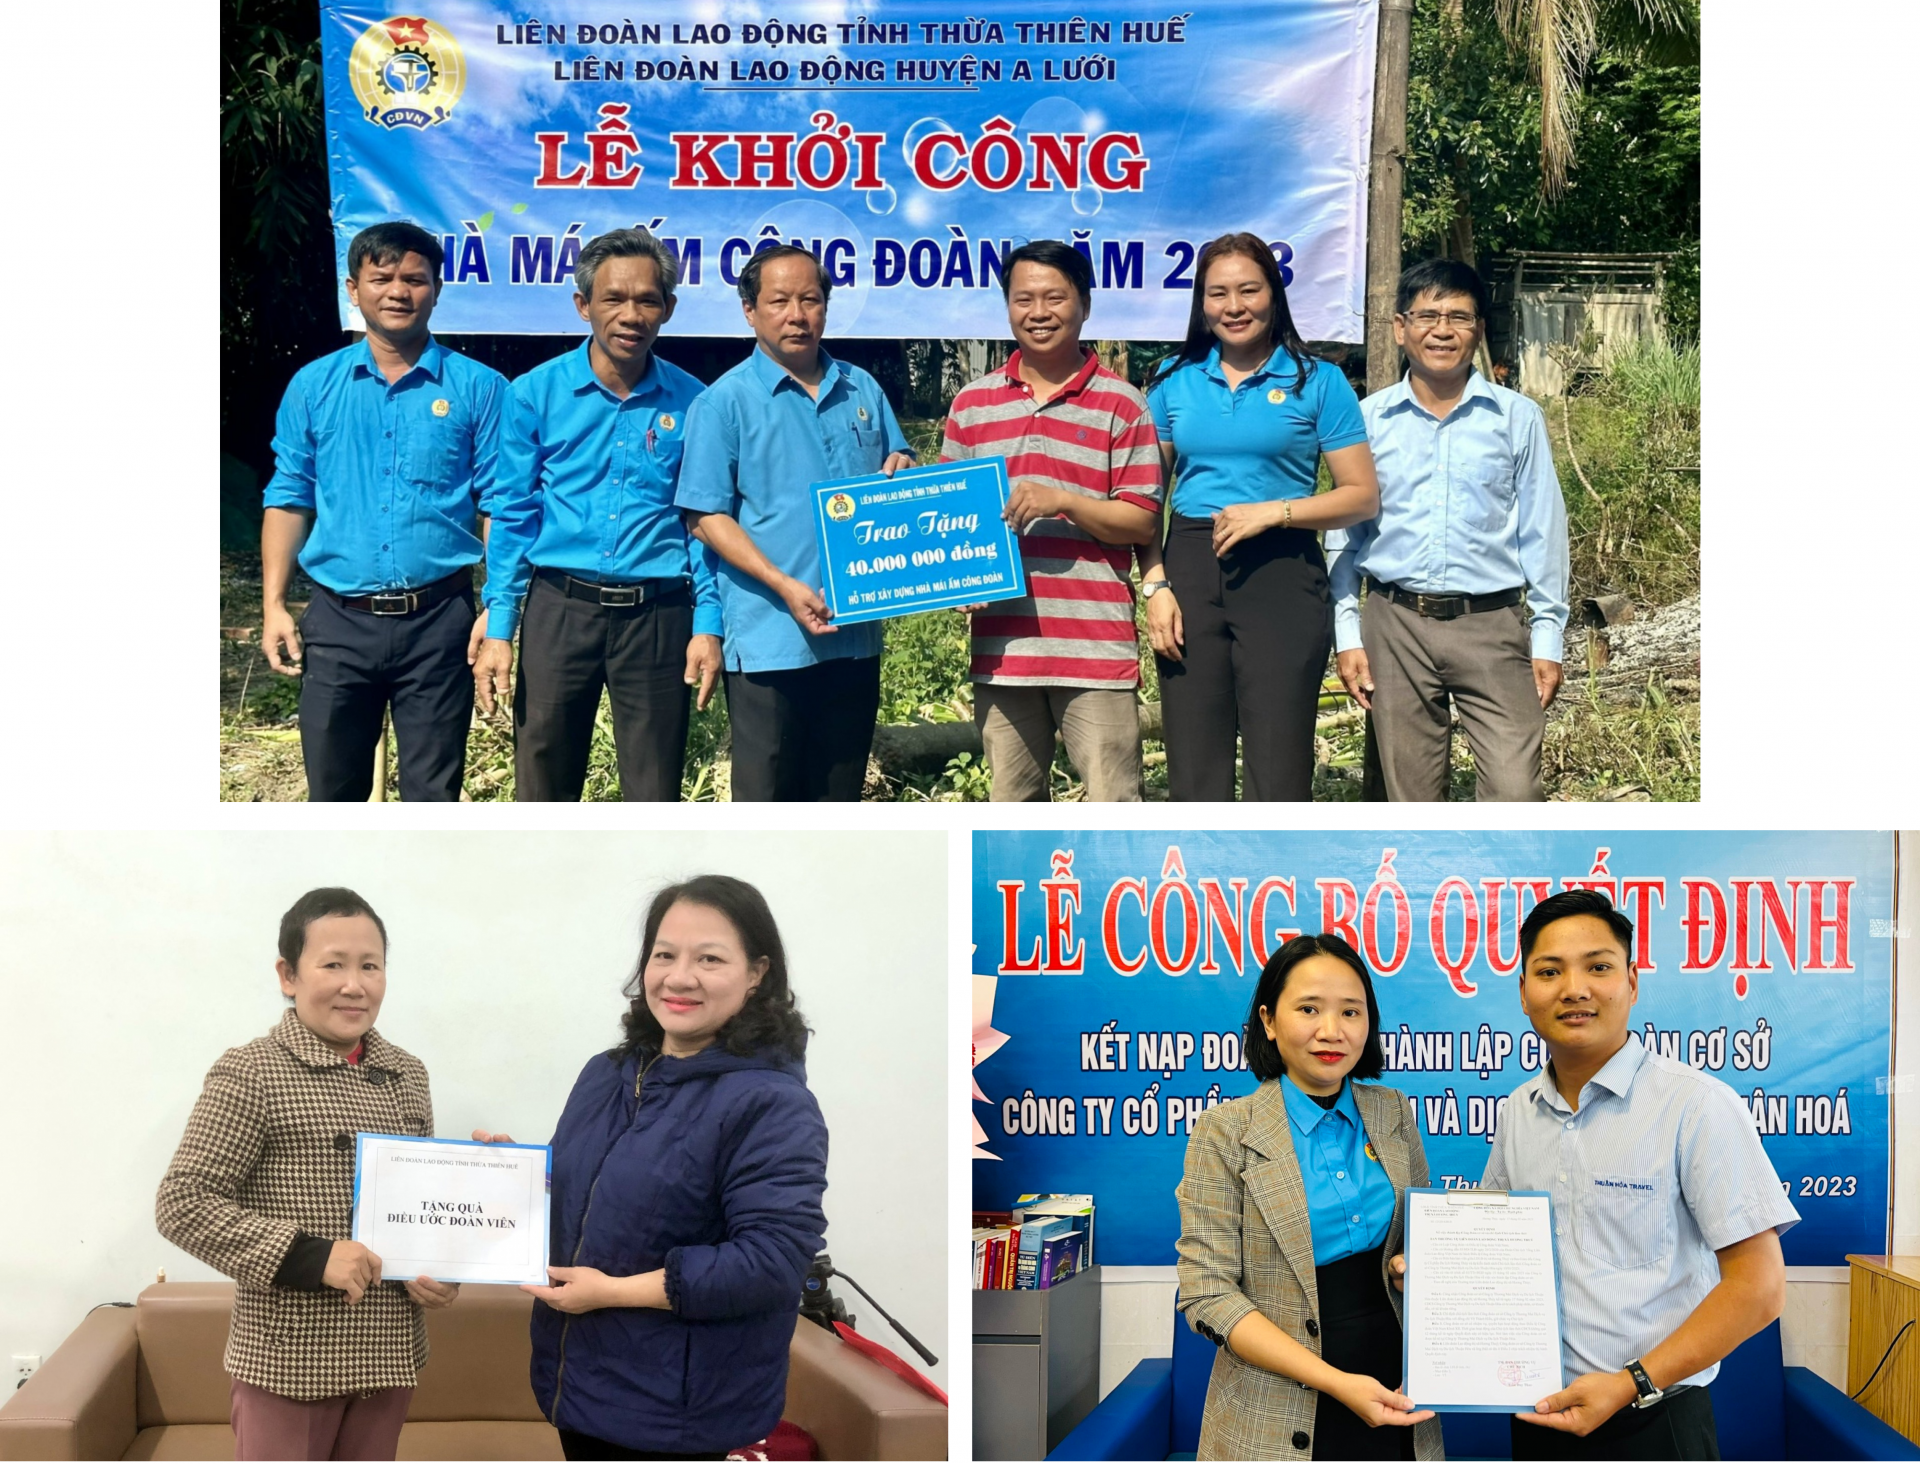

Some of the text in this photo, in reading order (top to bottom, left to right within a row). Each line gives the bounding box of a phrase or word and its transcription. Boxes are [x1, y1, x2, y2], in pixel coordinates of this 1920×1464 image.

[496, 12, 1194, 48] LIÊN ĐOÀN LAO ĐỘNG TỈNH THỪA THIÊN HUẾ
[554, 54, 1117, 86] LIÊN ĐOÀN LAO ĐỘNG HUYỆN A LƯỚI
[386, 112, 425, 124] CĐVN
[534, 102, 1150, 193] LỄ KHỞI CÔNG
[510, 222, 582, 285] MÁ
[872, 224, 1012, 289] ĐOÀN
[1065, 228, 1144, 289] ĂM
[1162, 240, 1295, 289] 23
[853, 511, 981, 545] Trao Tặng
[845, 540, 998, 577] 40.000 000 đồng
[877, 587, 892, 601] XÂY
[894, 585, 914, 599] DỰNG
[915, 581, 931, 595] NHÀ
[932, 579, 947, 592] MÁI
[962, 574, 982, 588] CÔNG
[983, 571, 1003, 585] ĐOÀN
[997, 846, 1857, 1000] LỄ CÔNG BỐ QUT ĐỊNH
[1080, 1019, 1131, 1071] KẾT
[1137, 1031, 1195, 1080] NẠP
[1202, 1025, 1252, 1071] ĐO
[1379, 1024, 1454, 1071] HÀNH
[1460, 1023, 1513, 1080] LẬP
[1687, 1026, 1727, 1071] CƠ
[1732, 1017, 1772, 1071] SỞ
[1002, 1088, 1076, 1136] CÔNG
[1083, 1097, 1115, 1136] TY
[1122, 1082, 1160, 1136] CỔ
[1425, 1088, 1462, 1136] VÀ
[1795, 1087, 1852, 1136] HOÁ
[1629, 1183, 1654, 1191] TRAVEL
[1799, 1175, 1858, 1197] 2023
[387, 1211, 516, 1229] ĐIỀU ƯỚC ĐOÀN VIÊN
[421, 1200, 483, 1215] TẶNG QUÀ
